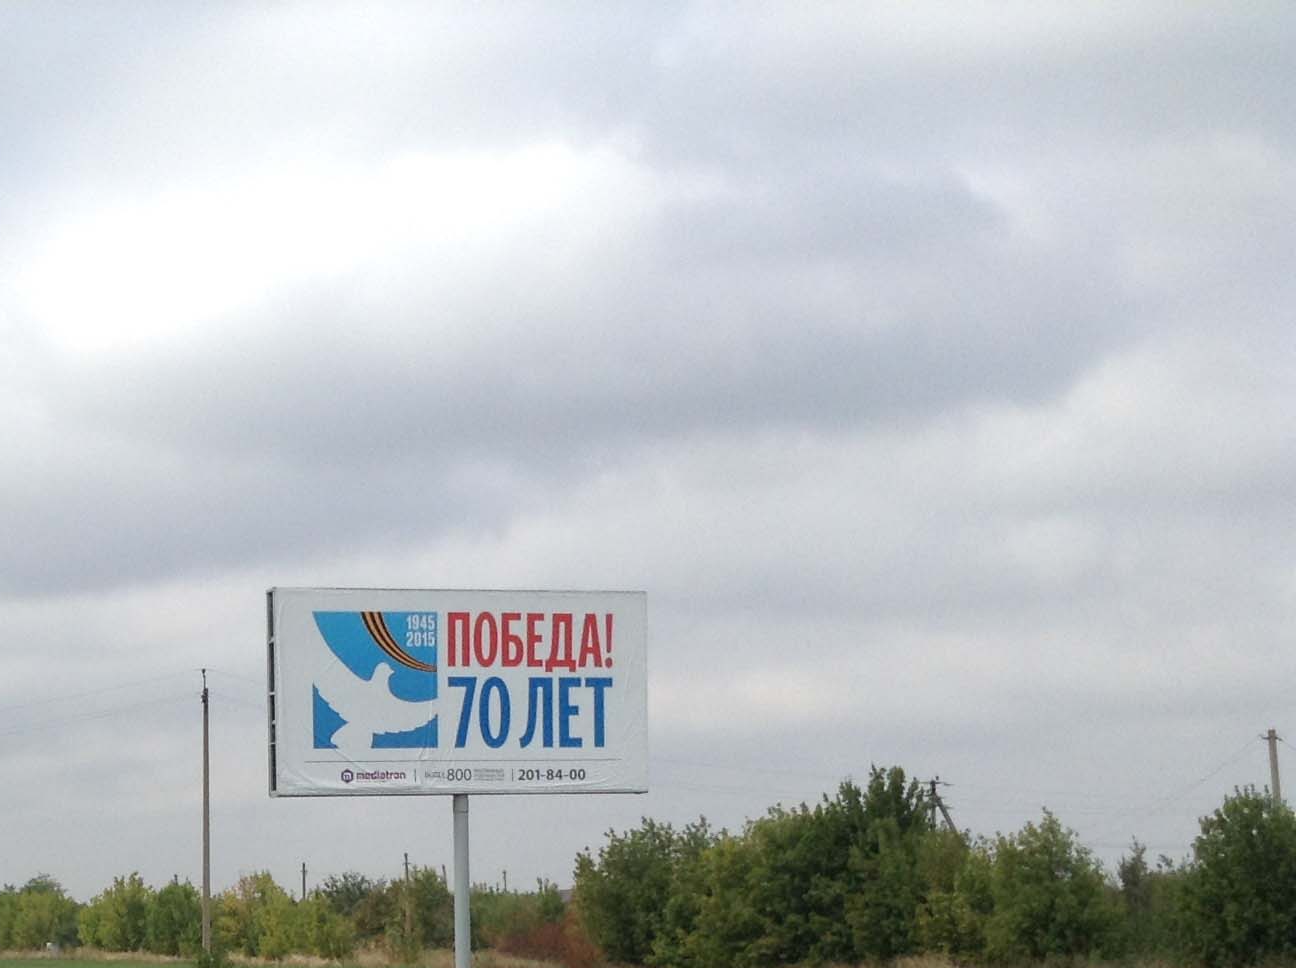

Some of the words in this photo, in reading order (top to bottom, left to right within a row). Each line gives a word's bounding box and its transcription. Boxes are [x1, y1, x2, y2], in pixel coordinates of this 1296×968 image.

[406, 614, 435, 630] 1945
[406, 631, 435, 647] 2015
[447, 611, 614, 673] ПОБЕДА!
[447, 676, 511, 749] 70
[519, 676, 613, 749] ЛЕТ
[356, 770, 406, 780] mediatron
[447, 768, 472, 781] 800
[518, 768, 586, 781] 201-84-00
